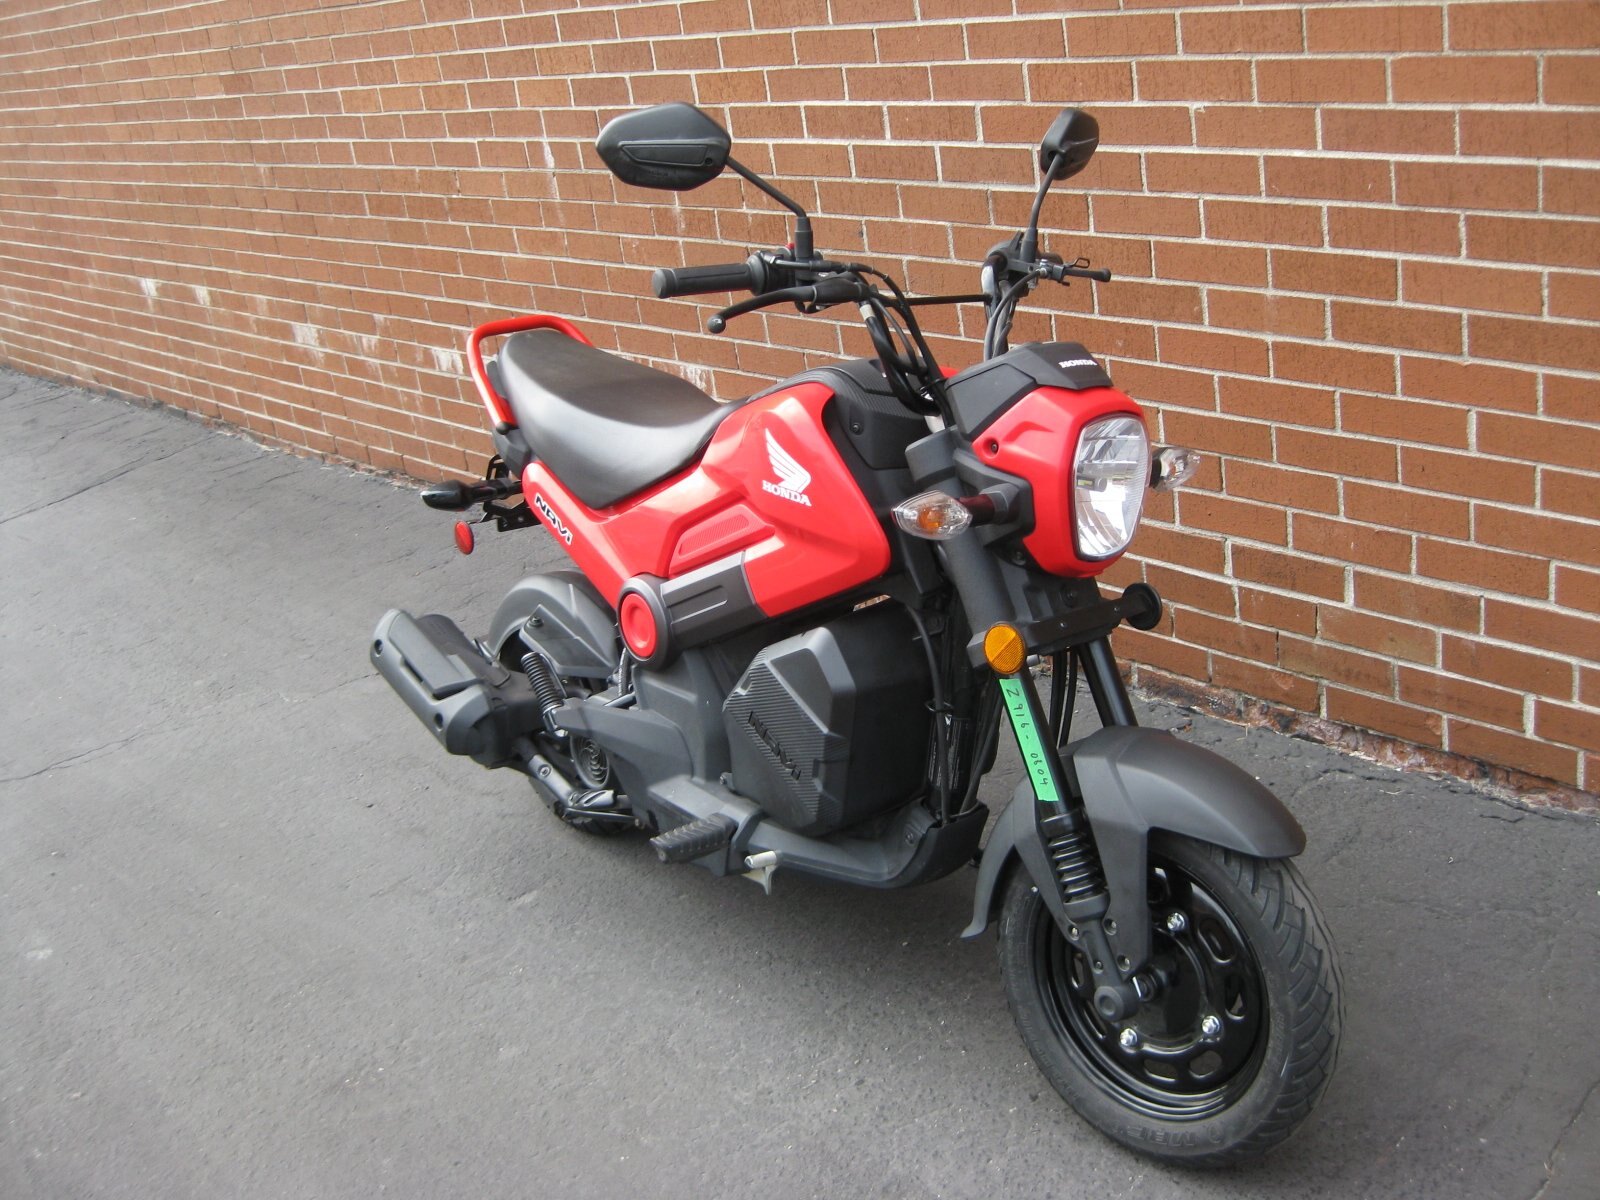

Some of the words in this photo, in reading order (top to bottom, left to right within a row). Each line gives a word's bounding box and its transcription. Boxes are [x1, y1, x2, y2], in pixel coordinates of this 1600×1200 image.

[1058, 359, 1098, 368] HONDA
[762, 480, 812, 507] HONDA
[534, 492, 573, 546] NAVI
